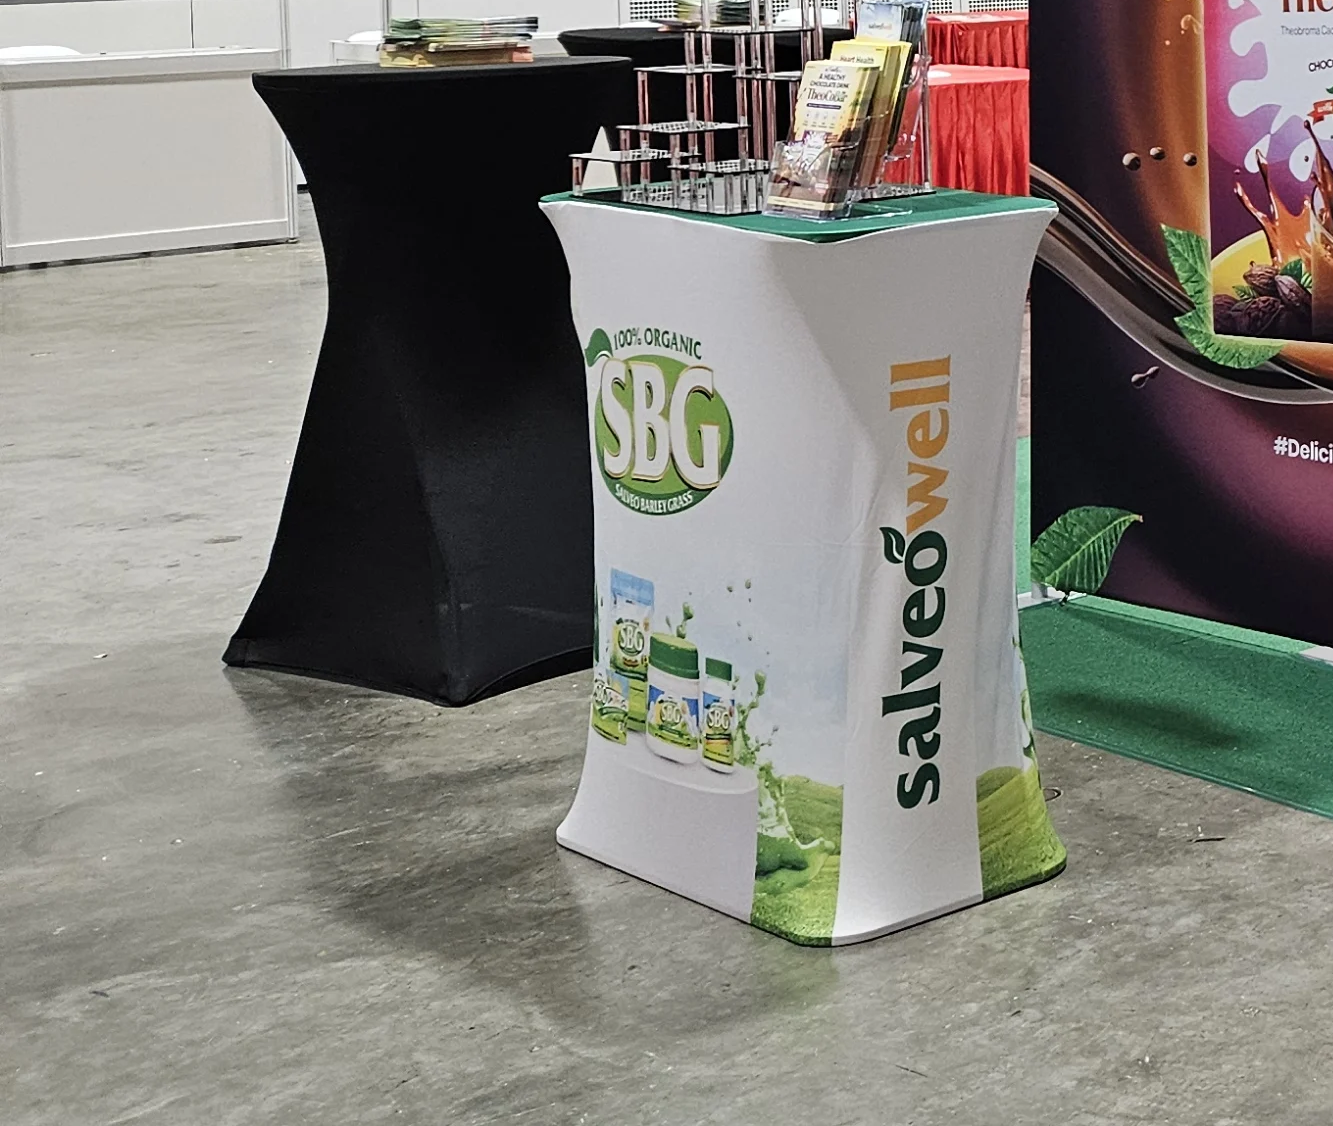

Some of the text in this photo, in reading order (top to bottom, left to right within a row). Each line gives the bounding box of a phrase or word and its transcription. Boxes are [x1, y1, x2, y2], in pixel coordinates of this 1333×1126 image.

[1281, 26, 1320, 35] Theobroma
[614, 327, 702, 360] 100% ORGANIC
[600, 358, 721, 491] SBG
[615, 484, 693, 513] SALVEO BARLEY GRASS
[881, 353, 951, 810] salveowell
[619, 625, 644, 652] SBG
[660, 703, 682, 724] SBG
[708, 711, 729, 729] SBG
